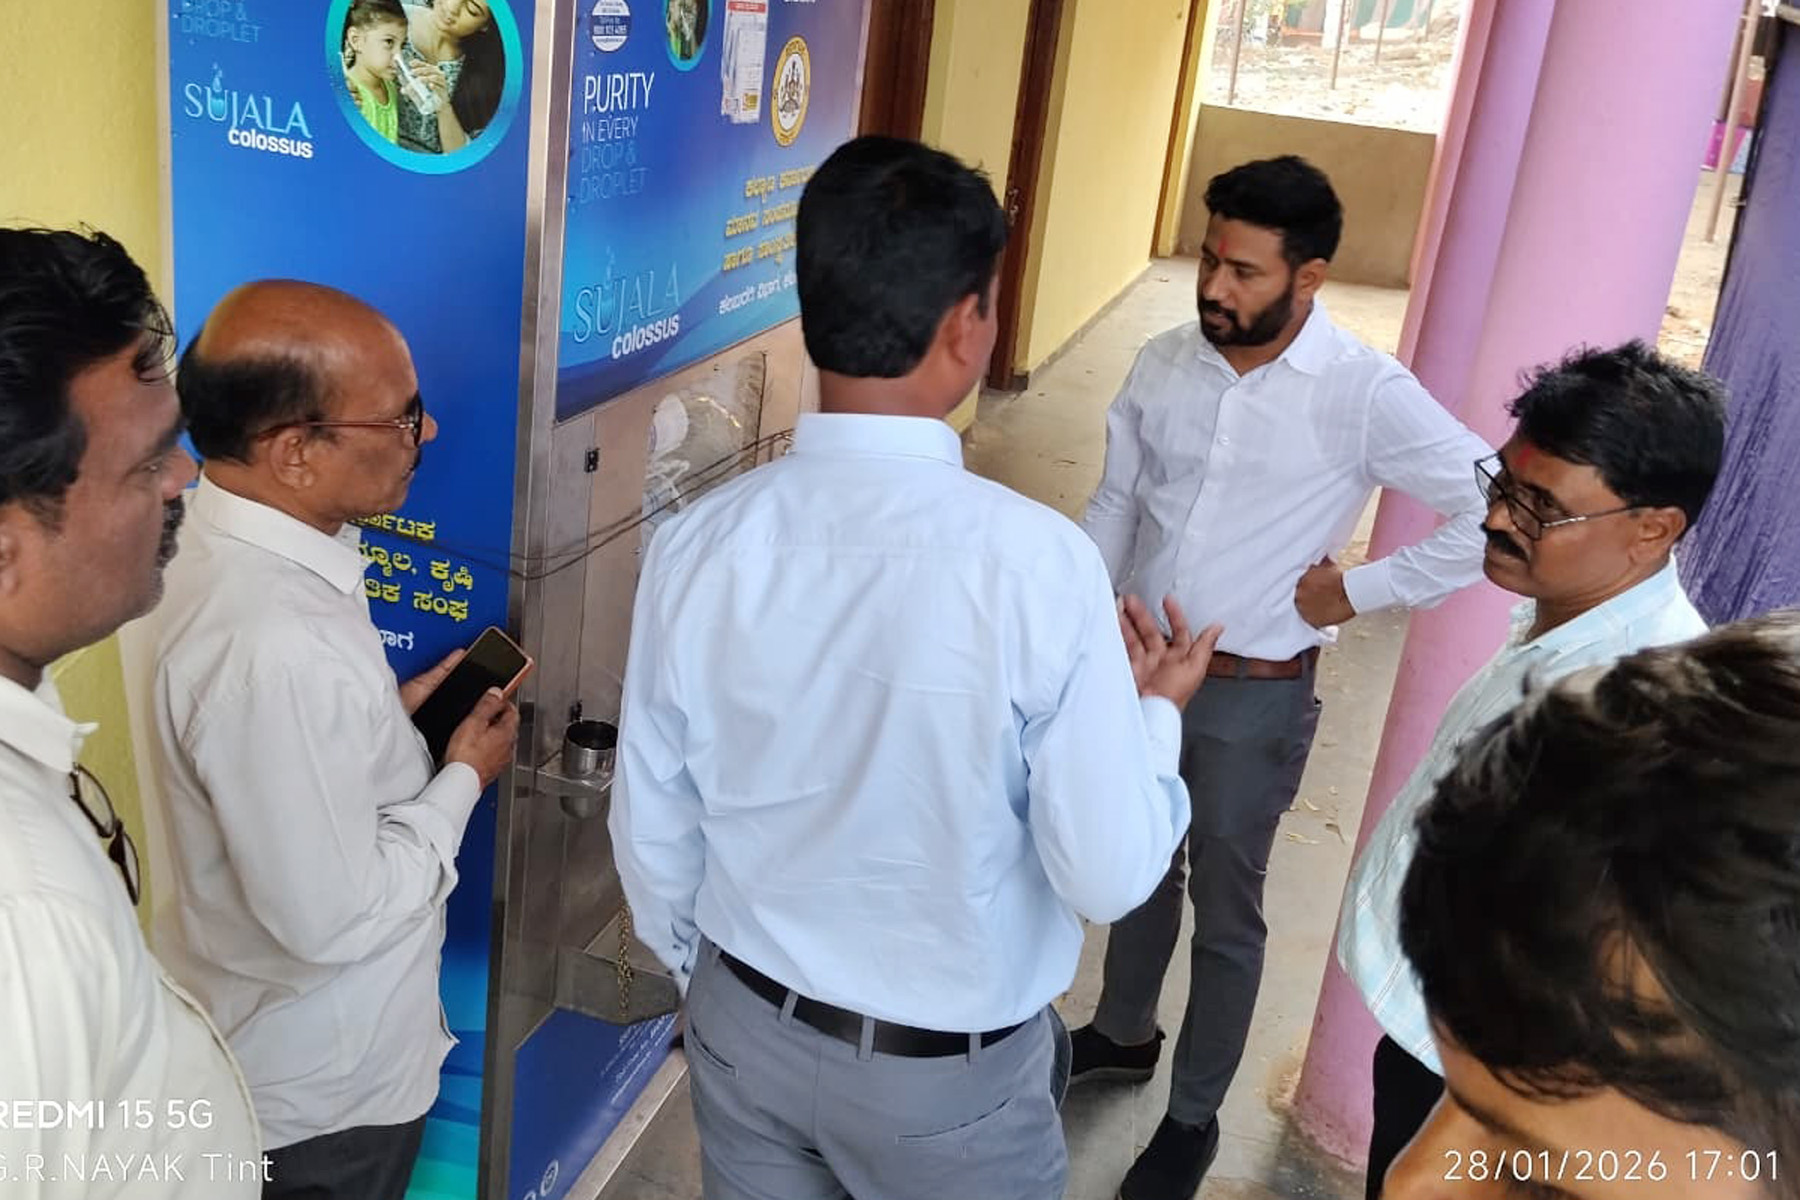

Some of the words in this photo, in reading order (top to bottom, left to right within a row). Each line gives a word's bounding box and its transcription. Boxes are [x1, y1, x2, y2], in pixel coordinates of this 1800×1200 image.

[181, 15, 262, 43] DROPLET
[184, 83, 313, 139] SUJALA
[584, 72, 655, 114] PURITY
[228, 128, 313, 159] colossus
[582, 121, 595, 143] IN
[598, 116, 638, 141] EVERY
[574, 262, 681, 343] SUJALA
[612, 313, 681, 360] colossus
